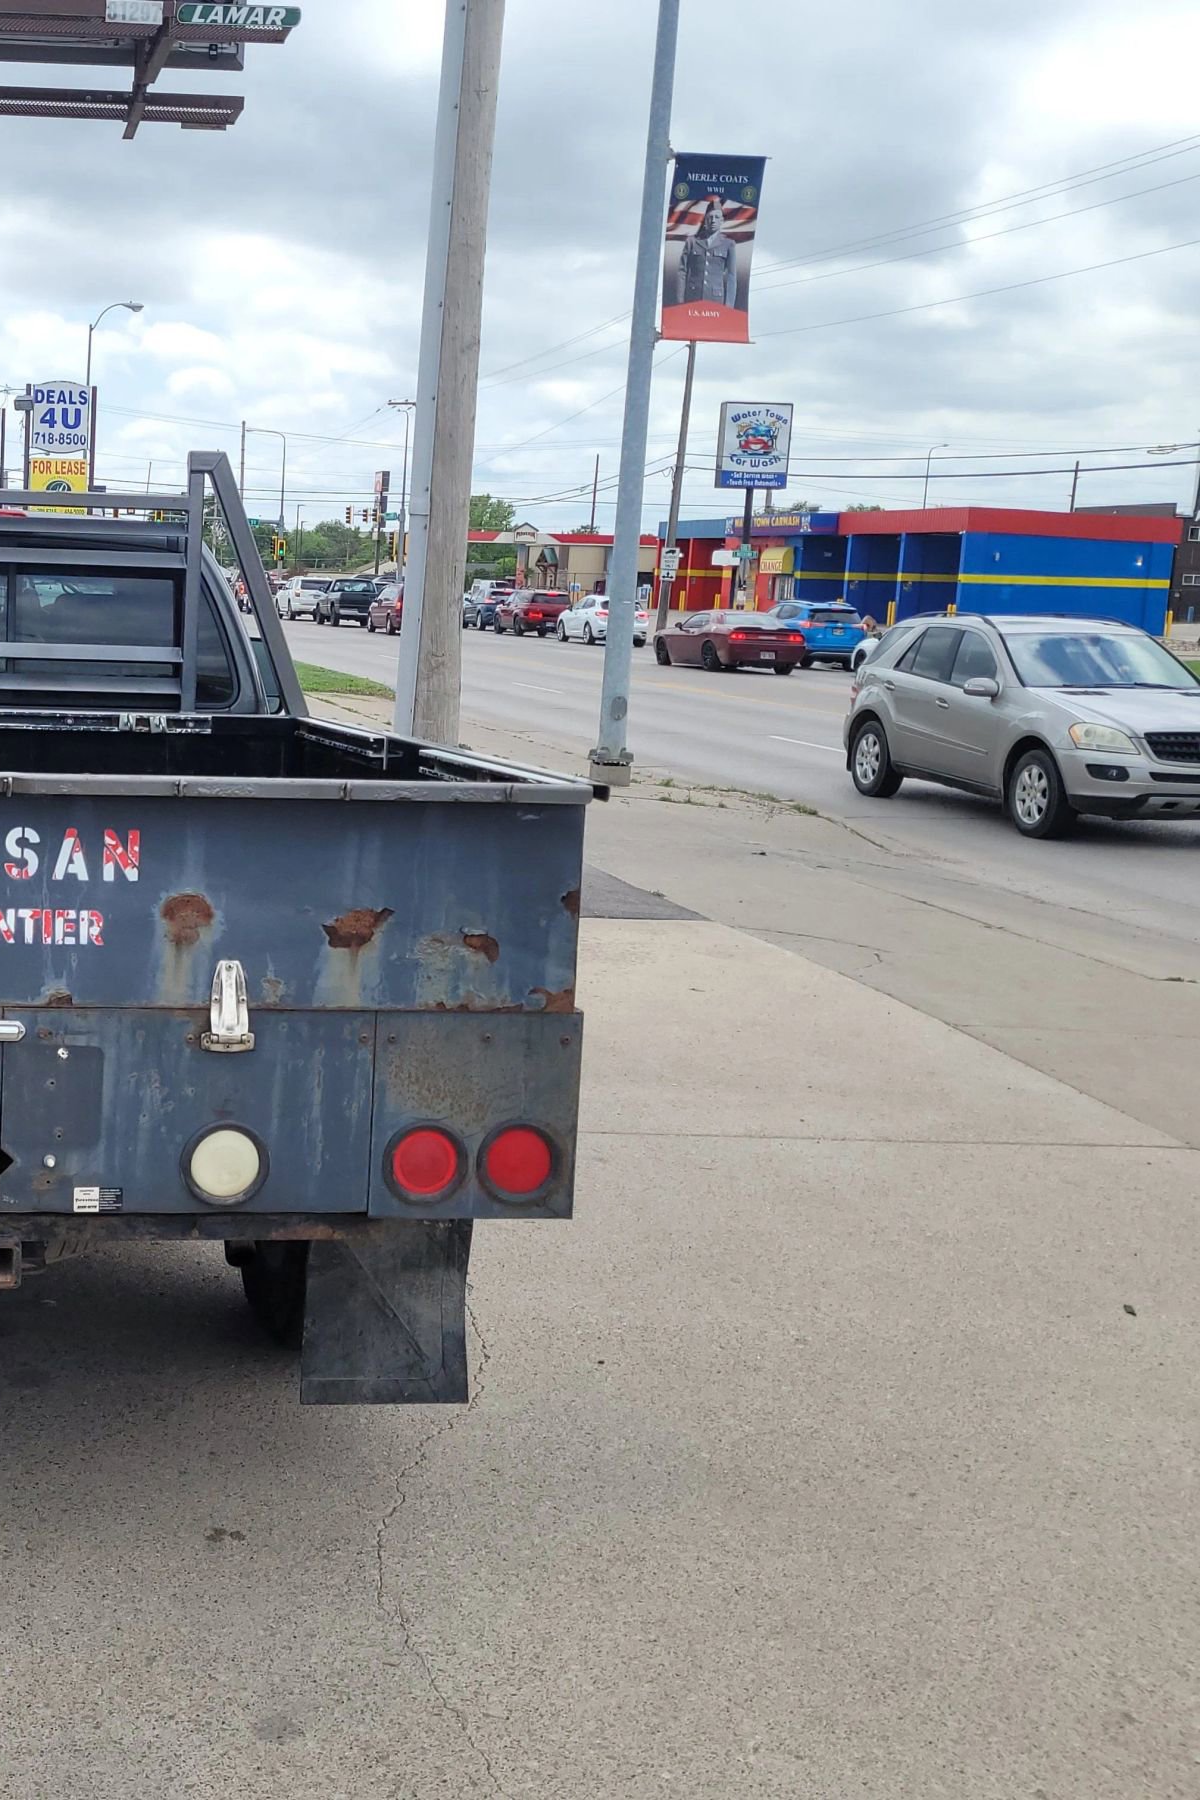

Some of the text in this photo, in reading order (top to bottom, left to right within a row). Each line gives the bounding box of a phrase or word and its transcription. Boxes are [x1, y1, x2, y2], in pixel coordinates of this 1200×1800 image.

[191, 5, 287, 25] LAMAR
[687, 172, 749, 184] MERLE COATS
[702, 310, 720, 318] ARMY
[35, 389, 88, 405] DEALS
[731, 409, 788, 425] Water Town
[32, 460, 86, 476] FOR LEASE
[730, 454, 781, 468] Car Wash
[754, 517, 770, 528] TOWN
[771, 515, 800, 527] CARWASH
[760, 560, 783, 572] CHANGE
